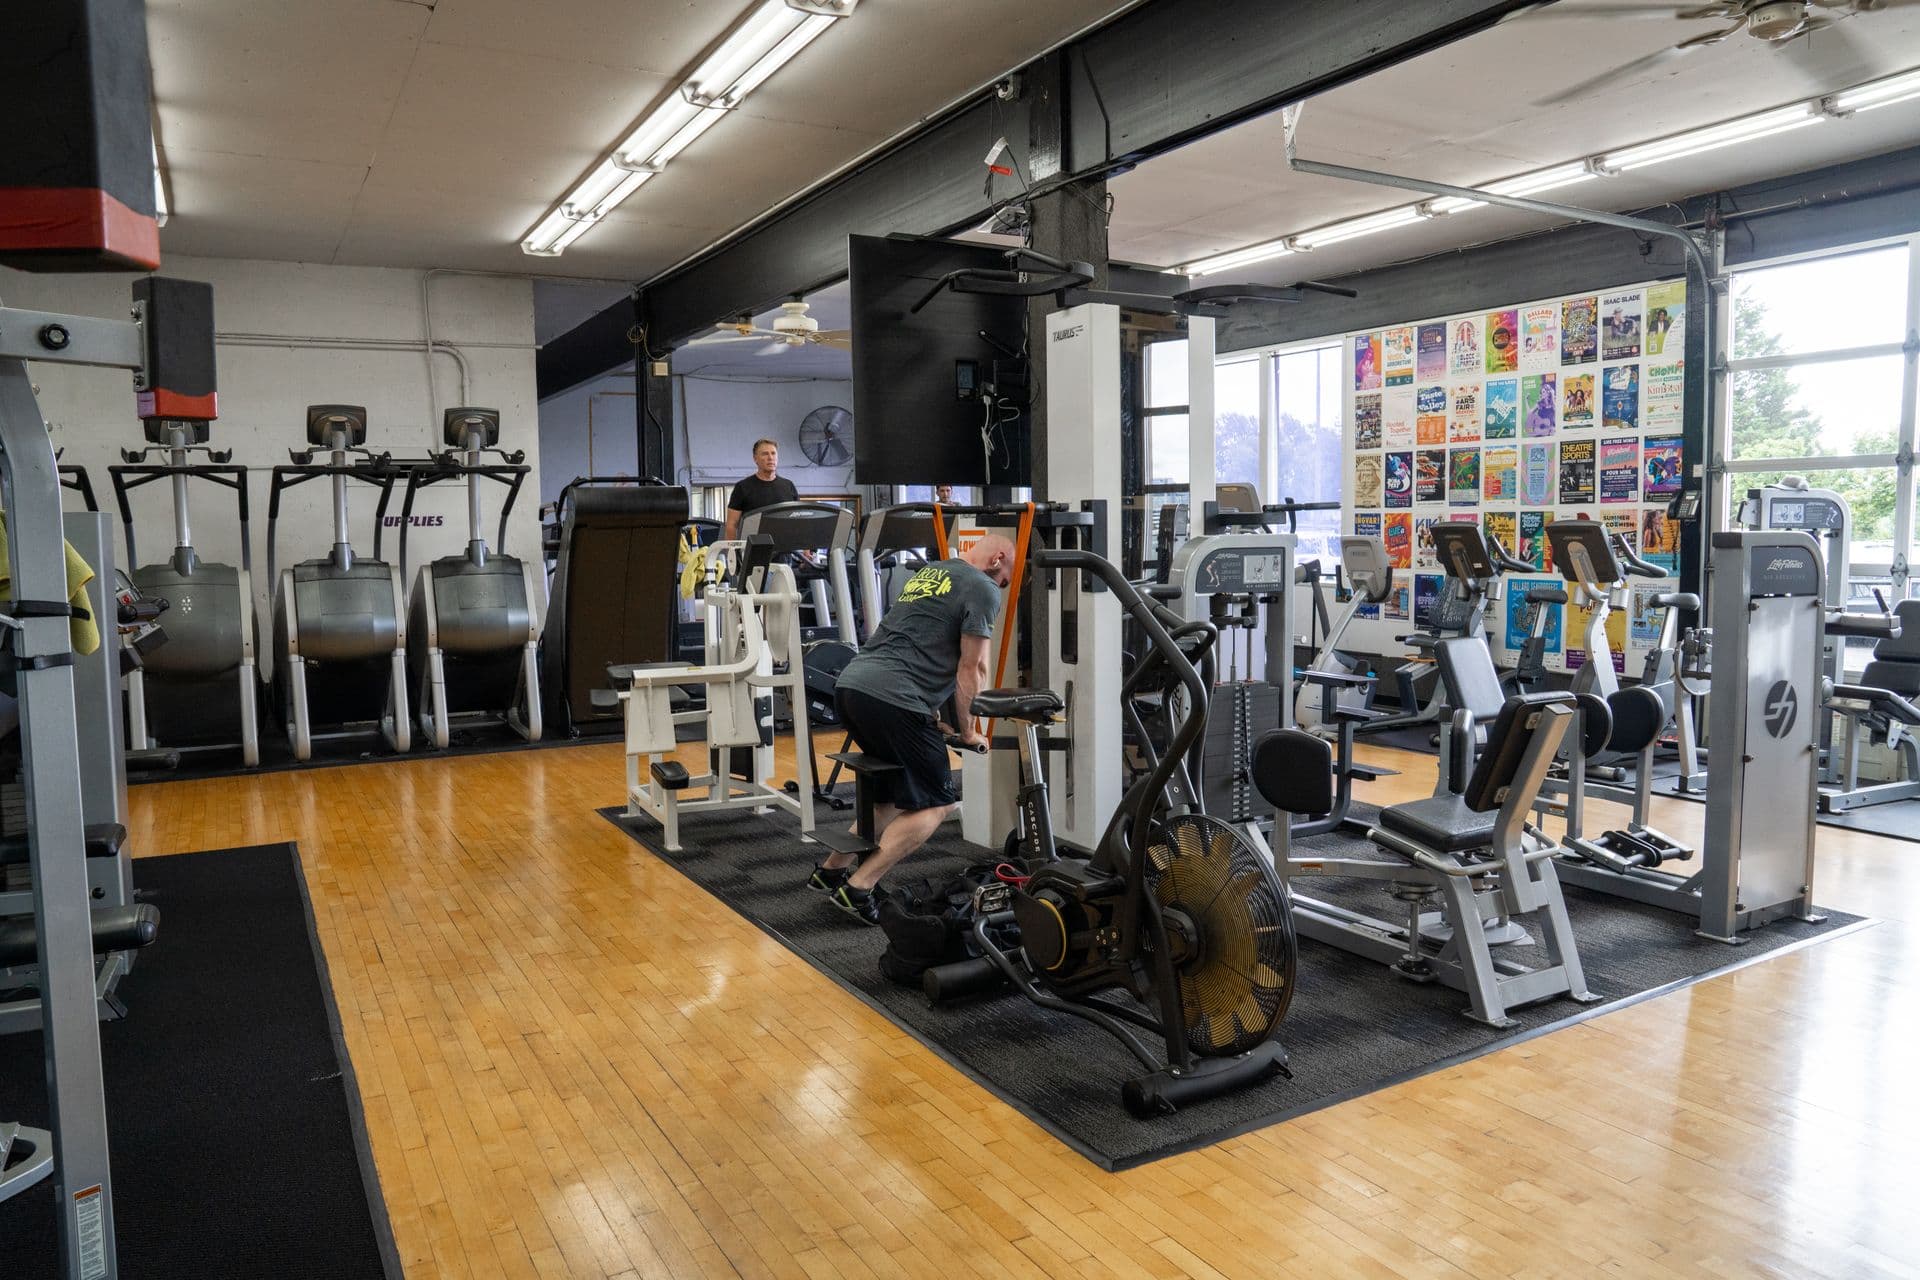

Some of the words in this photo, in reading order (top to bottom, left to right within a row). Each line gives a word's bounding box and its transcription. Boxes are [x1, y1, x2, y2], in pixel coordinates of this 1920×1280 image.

[1621, 294, 1640, 303] SLADE
[1420, 391, 1442, 400] Taste
[1418, 401, 1445, 411] Valley
[1561, 443, 1593, 453] THEATRE
[1561, 451, 1590, 460] SPORTS
[383, 516, 443, 527] UPPLIES
[1511, 582, 1530, 591] BALLARD
